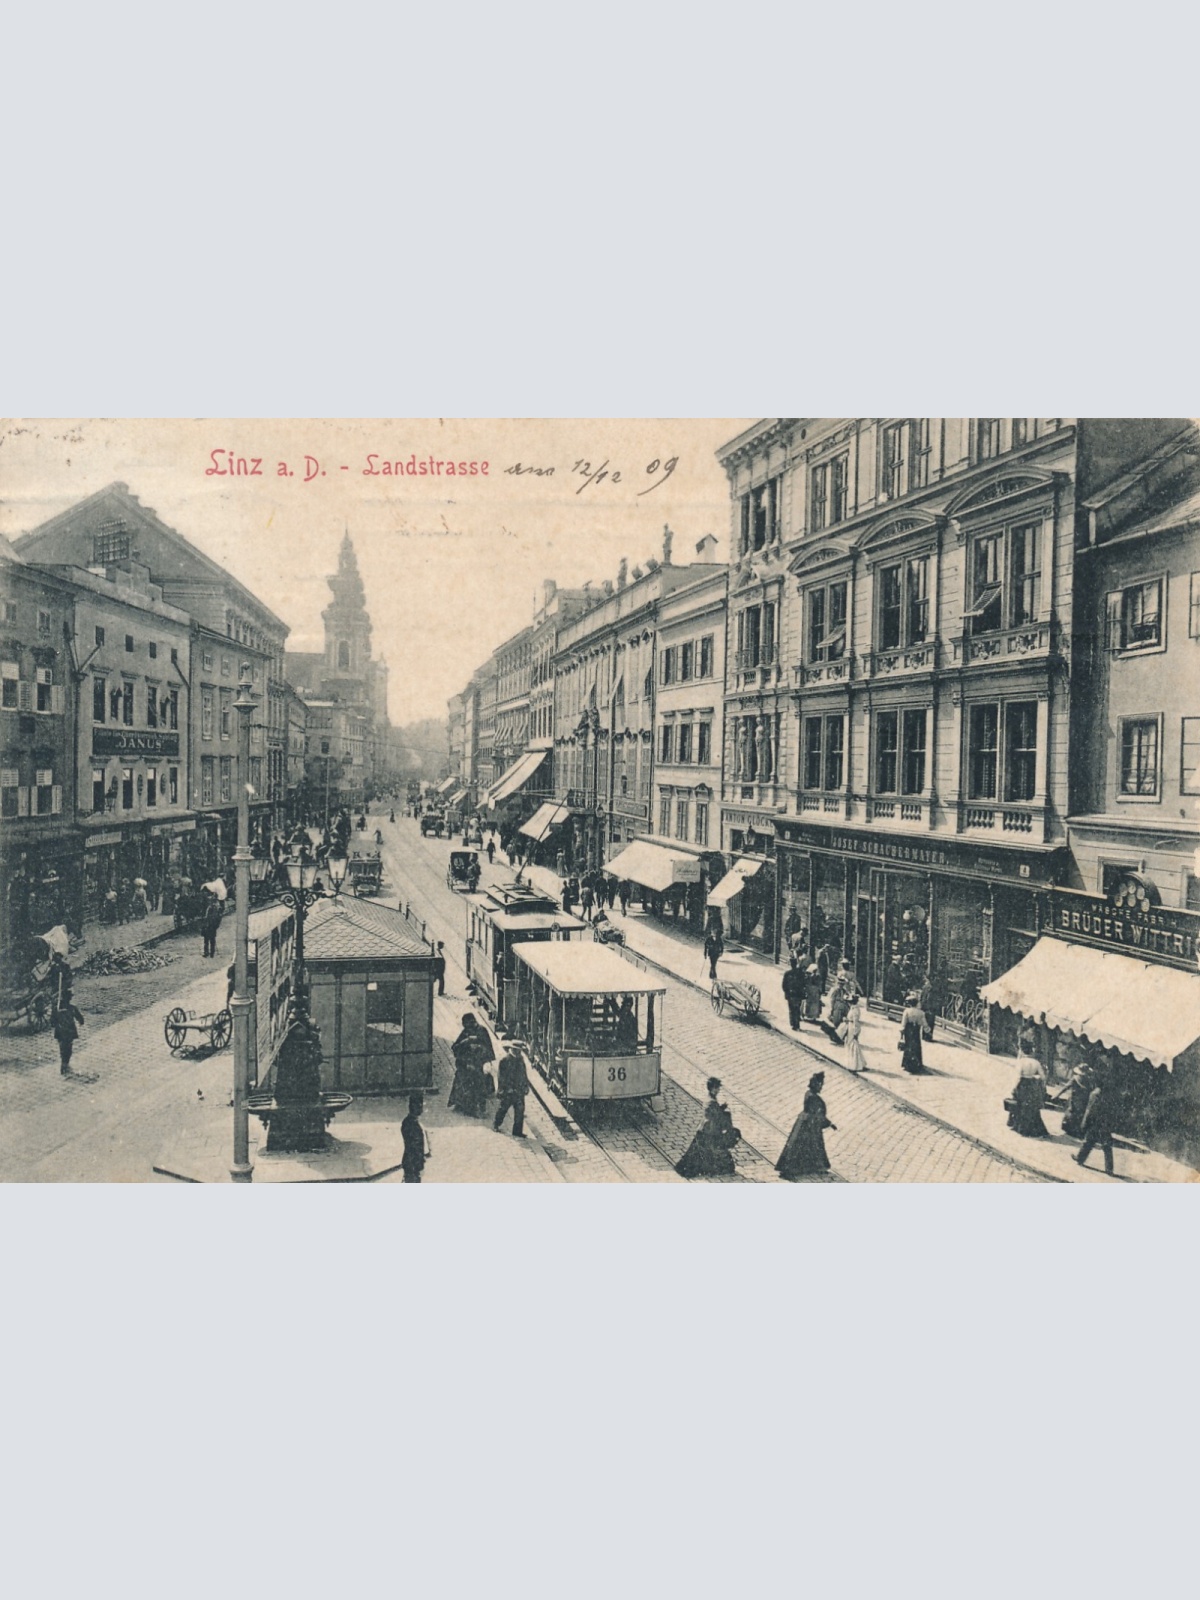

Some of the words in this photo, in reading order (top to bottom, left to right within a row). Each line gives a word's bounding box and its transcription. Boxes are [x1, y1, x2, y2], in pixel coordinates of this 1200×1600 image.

[725, 812, 745, 824] ANTON
[832, 837, 859, 851] JOSEF
[1061, 909, 1123, 941] BRÜDER
[607, 1067, 627, 1082] 36
